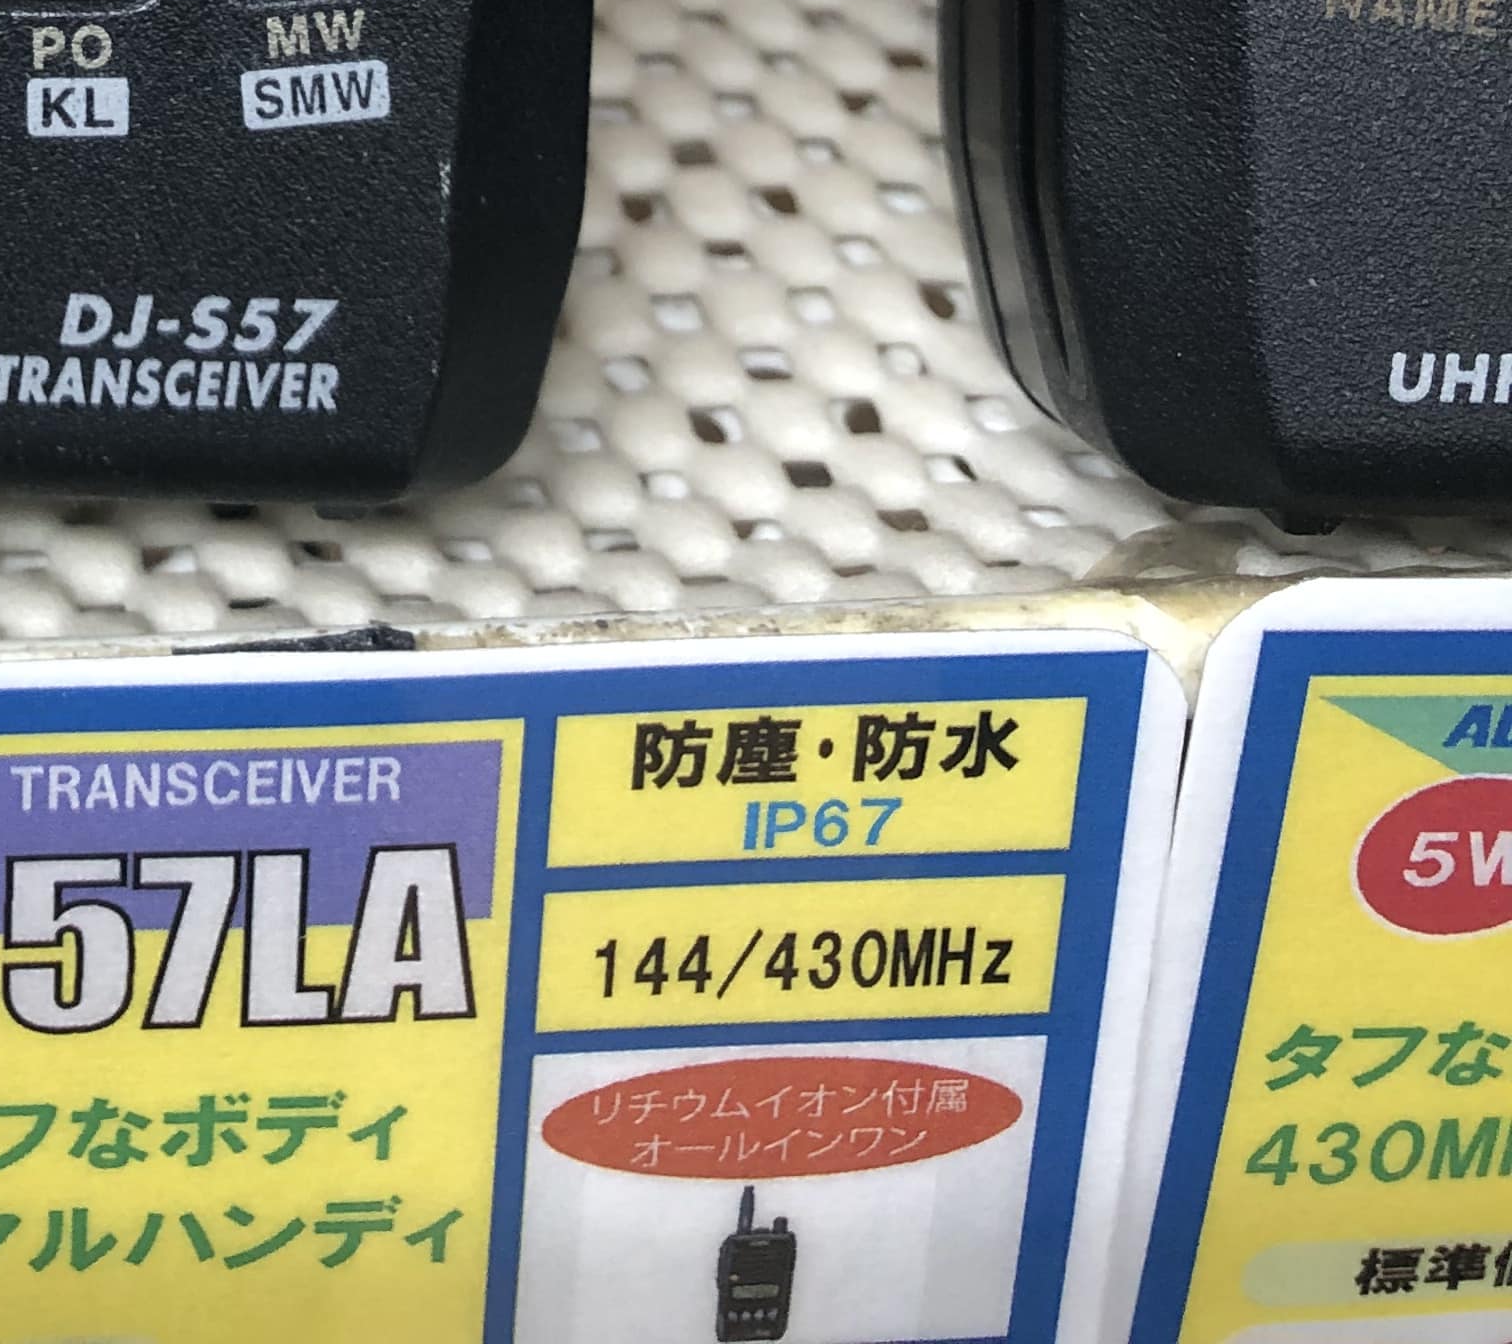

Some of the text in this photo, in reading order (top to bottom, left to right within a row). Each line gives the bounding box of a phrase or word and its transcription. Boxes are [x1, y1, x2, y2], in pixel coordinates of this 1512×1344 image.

[32, 25, 113, 69] PO
[268, 11, 365, 59] MW
[41, 85, 116, 129] KL
[254, 72, 375, 120] SMW
[59, 292, 340, 355] DJ-S57
[631, 709, 1020, 791] 防塵・防水
[11, 757, 402, 812] TRANSCEIVER
[742, 796, 904, 851] IP67
[595, 926, 1014, 1000] 144/430MHz
[591, 1078, 969, 1123] リチウムイオン付属
[630, 1126, 927, 1169] オールインワン
